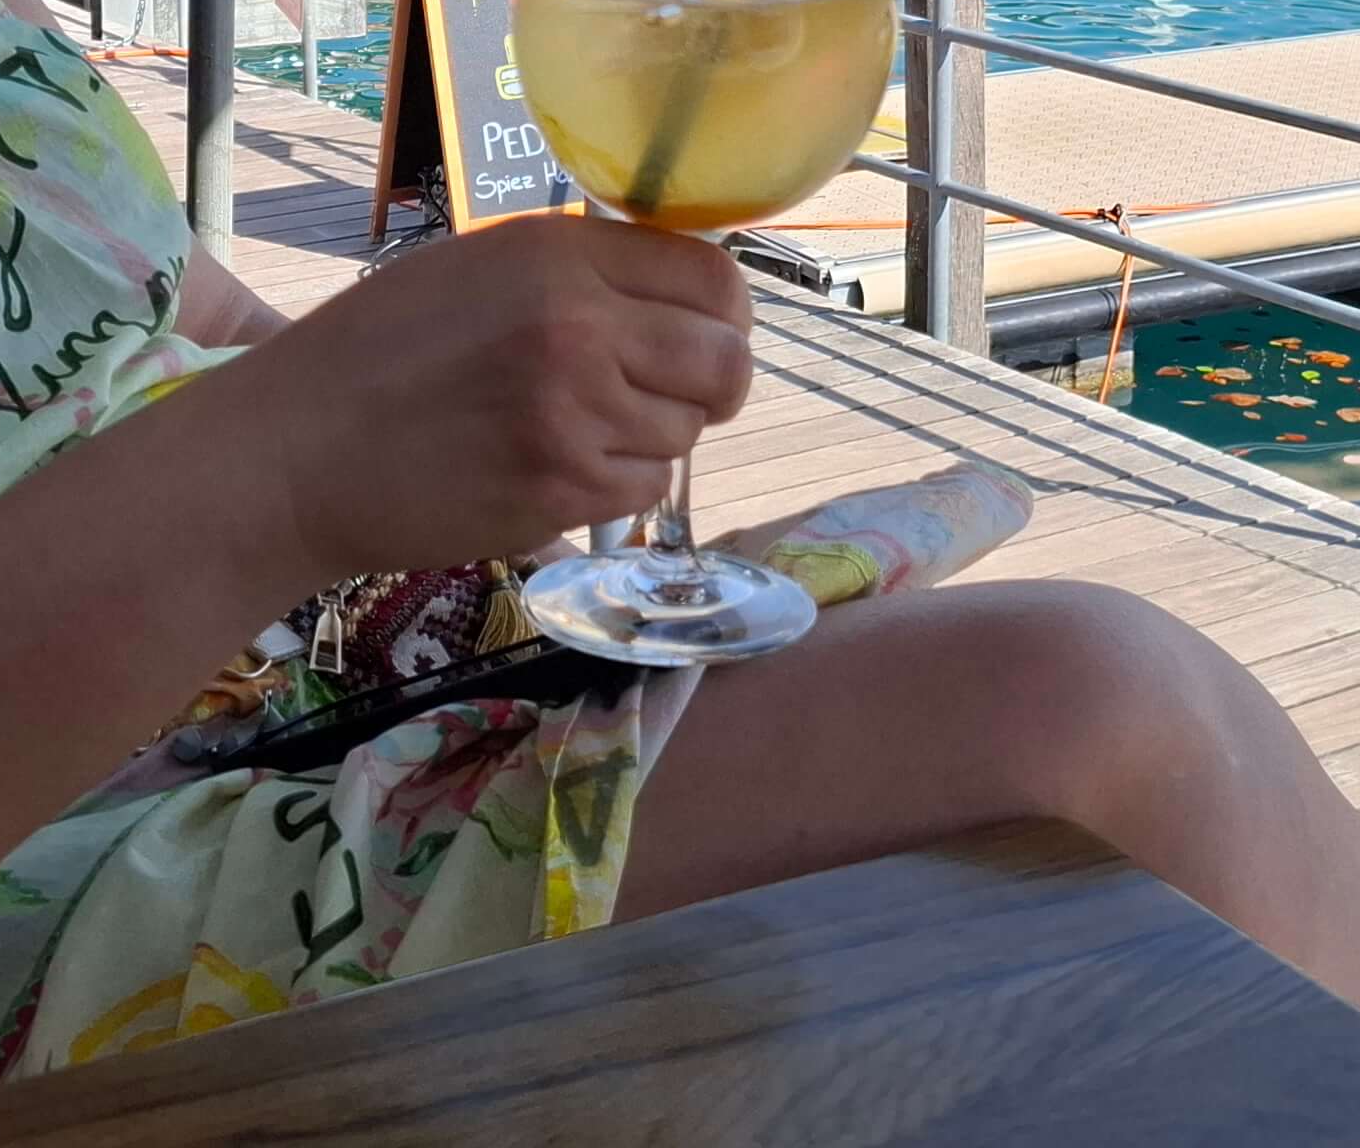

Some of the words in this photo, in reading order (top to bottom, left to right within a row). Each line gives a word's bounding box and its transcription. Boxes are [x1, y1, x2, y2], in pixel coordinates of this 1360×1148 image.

[482, 121, 546, 163] PED
[475, 170, 535, 204] Spiez
[543, 160, 575, 186] Ha
